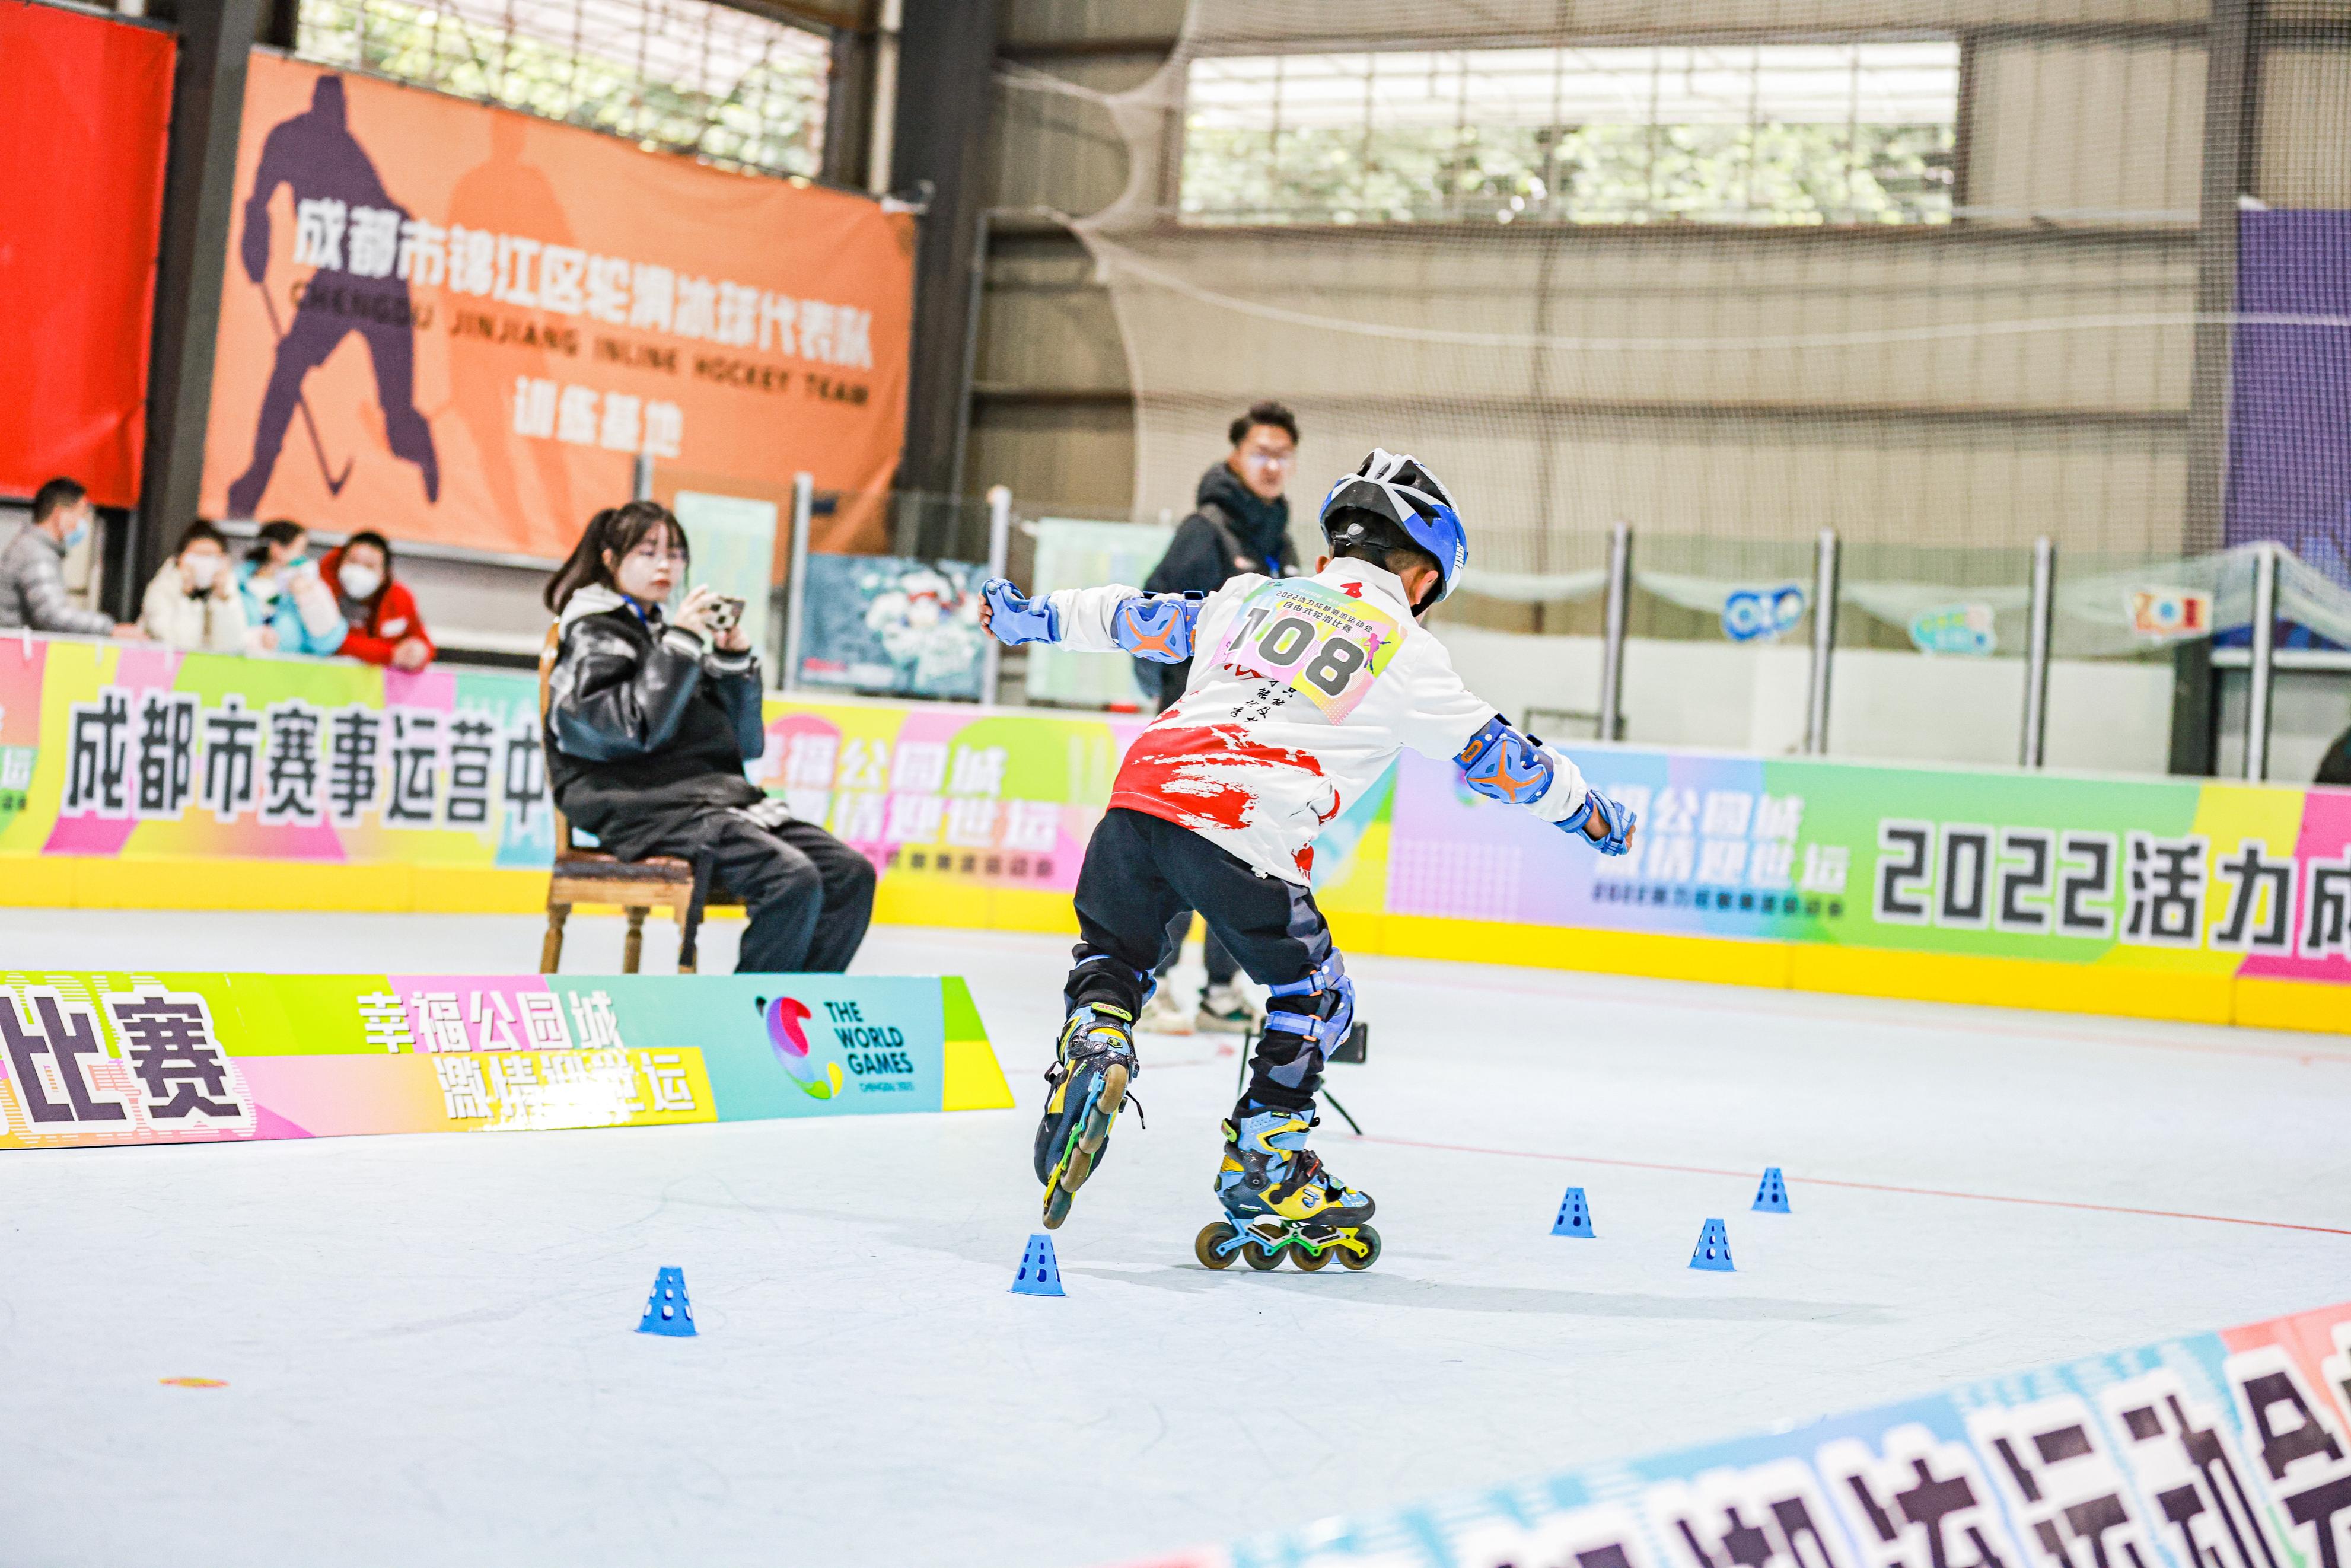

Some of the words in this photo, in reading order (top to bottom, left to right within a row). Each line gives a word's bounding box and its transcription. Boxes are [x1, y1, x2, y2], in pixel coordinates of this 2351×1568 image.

[1276, 591, 1373, 633] 2022活力成都潮流运动会
[1283, 601, 1353, 634] 自由式轮滑比赛
[1227, 607, 1365, 697] 108
[67, 694, 544, 824] 成都市赛事运营中
[357, 991, 625, 1054] 幸福公园城
[824, 1001, 864, 1023] THE
[0, 996, 239, 1122] 比赛
[834, 1026, 904, 1050] WORLD
[847, 1051, 914, 1075] GAMES
